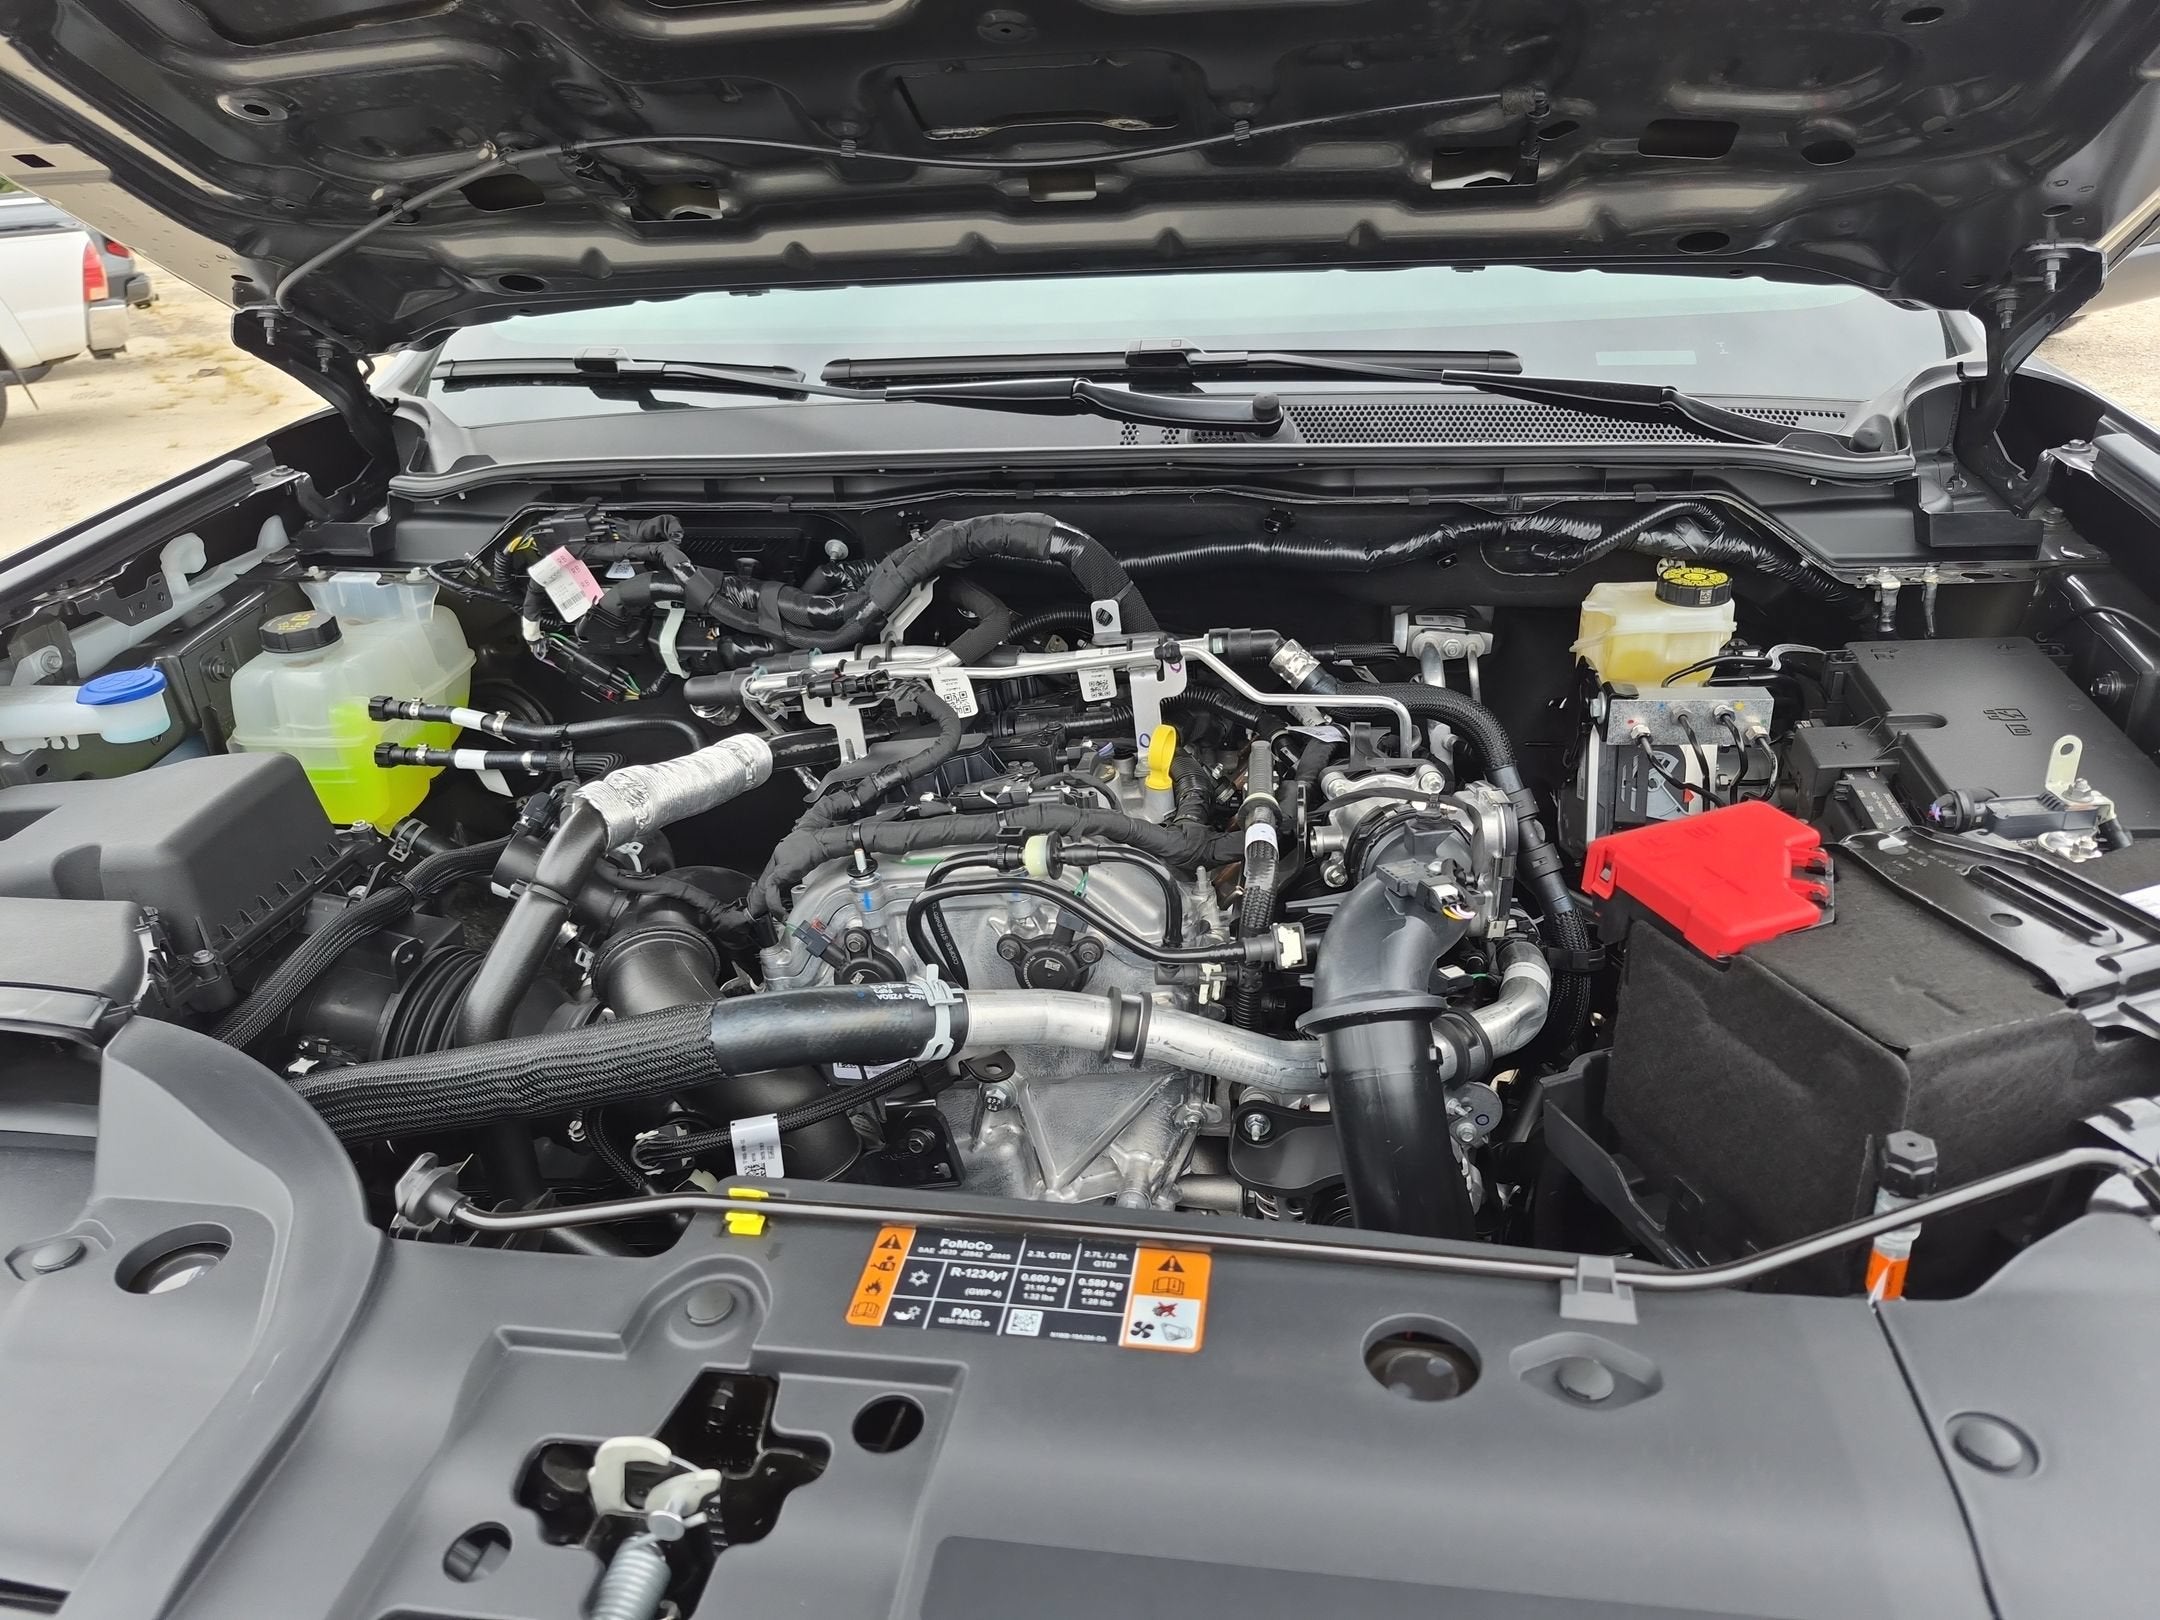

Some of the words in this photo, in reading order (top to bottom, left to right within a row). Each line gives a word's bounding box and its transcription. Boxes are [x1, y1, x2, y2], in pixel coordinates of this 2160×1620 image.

[917, 1246, 936, 1254] SAE
[940, 1238, 994, 1251] FoMoCo
[1027, 1250, 1047, 1259] 2.3L
[1083, 1250, 1104, 1259] 2.7L
[950, 1266, 1009, 1282] R-1234yf
[1020, 1273, 1050, 1283] 0.600
[1051, 1275, 1066, 1286] kg
[1078, 1277, 1108, 1288] 0.580
[1109, 1280, 1124, 1291] kg
[1041, 1294, 1055, 1302] lbs
[1100, 1299, 1114, 1307] lbs
[951, 1307, 982, 1320] PAG
